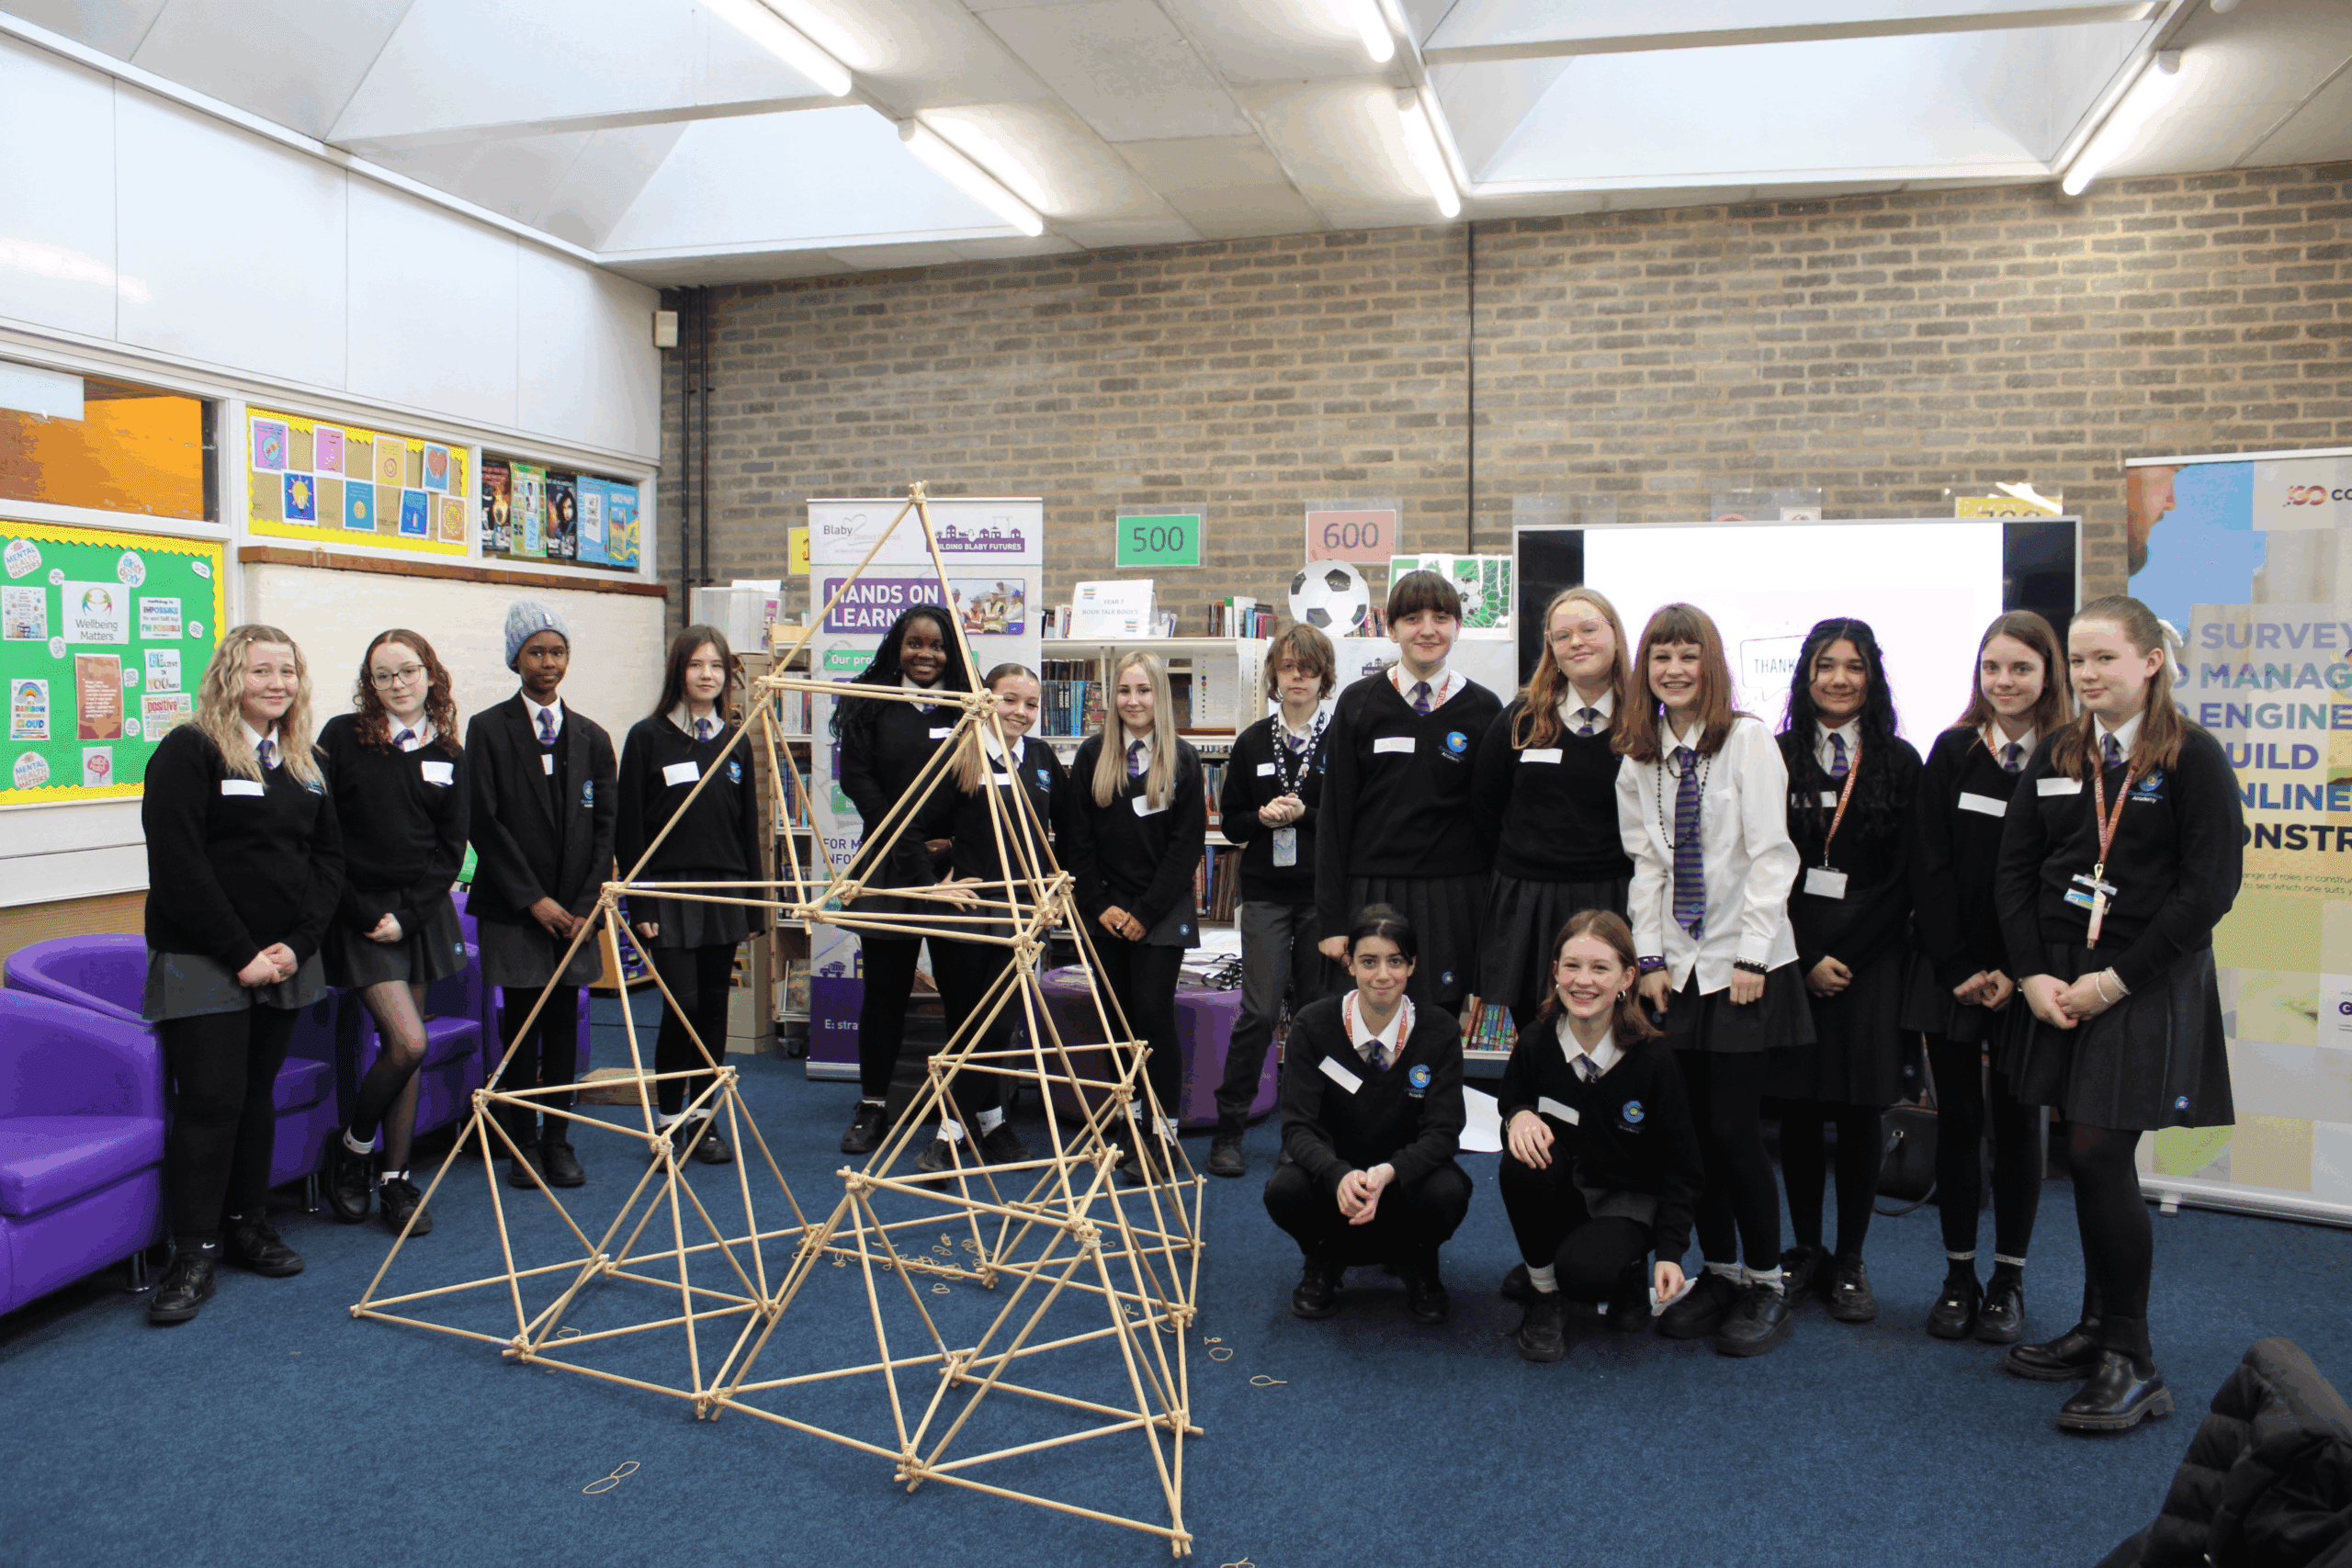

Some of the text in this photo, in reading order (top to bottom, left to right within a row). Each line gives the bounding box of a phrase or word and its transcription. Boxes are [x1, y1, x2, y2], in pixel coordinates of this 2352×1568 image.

[823, 525, 853, 536] Blaby
[1323, 521, 1379, 549] 600
[1132, 526, 1184, 552] 500
[6, 547, 36, 563] MENTAL
[9, 553, 42, 570] HEALTH
[10, 560, 40, 578] MATTERS
[831, 584, 939, 604] HANDS ON
[75, 619, 119, 632] Wellbeing
[81, 631, 115, 641] Matters
[831, 654, 875, 667] Our pro
[148, 701, 177, 713] positive
[16, 718, 45, 728] CLOUD
[2199, 702, 2352, 730] ENGINE
[2225, 742, 2320, 770] UILD
[16, 761, 45, 774] MENTAL
[17, 768, 48, 782] HEALTH
[18, 775, 48, 789] MATTERS
[1840, 773, 1855, 802] STUDENT
[2116, 773, 2132, 805] STUDENT
[2240, 783, 2352, 812] NLINE
[2098, 815, 2108, 847] STUDENT
[823, 838, 847, 850] FOR
[2267, 872, 2277, 880] of
[2275, 883, 2301, 891] which
[824, 1020, 860, 1030] E: stra
